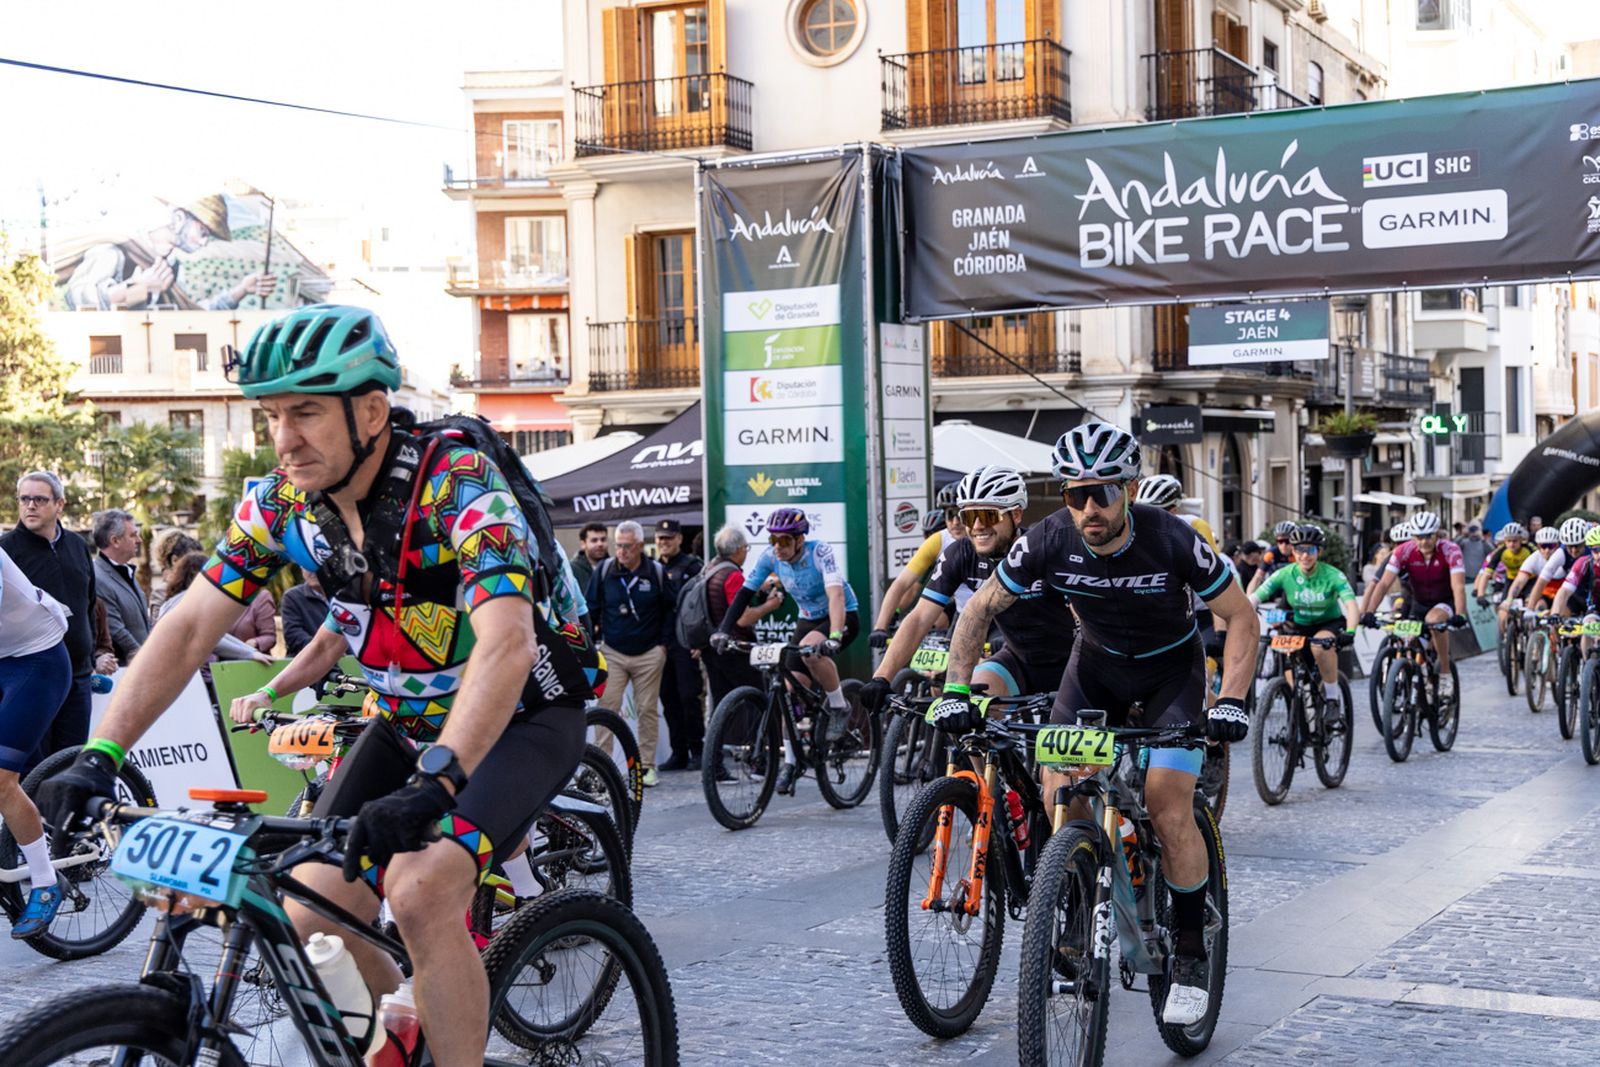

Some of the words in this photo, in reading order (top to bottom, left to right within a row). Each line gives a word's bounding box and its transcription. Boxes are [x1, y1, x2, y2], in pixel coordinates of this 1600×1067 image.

[931, 161, 1005, 185] Andalucía
[1074, 139, 1348, 220] Andalucía
[1375, 160, 1423, 181] UCI
[1434, 156, 1472, 175] SHC
[729, 206, 835, 242] Andalucía
[952, 204, 1026, 228] GRANADA
[968, 226, 1010, 251] JAÉN
[1079, 216, 1190, 269] BIKE
[1203, 204, 1350, 260] RACE
[1351, 206, 1362, 214] BY
[1379, 207, 1491, 231] GARMIN
[953, 252, 1027, 276] CÓRDOBA
[1224, 309, 1276, 324] STAGE
[1279, 308, 1291, 321] 4
[1237, 324, 1279, 340] JAÉN
[1232, 347, 1283, 358] GARMIN
[885, 385, 921, 398] GARMIN
[738, 426, 829, 446] GARMIN
[1543, 446, 1600, 467] garmin.com
[914, 651, 946, 666] 404-1
[532, 644, 566, 701] Slawe
[128, 742, 208, 769] AMIENTO
[1041, 730, 1109, 757] 402-2
[127, 822, 232, 887] 501-2
[262, 938, 356, 1067] SCO
